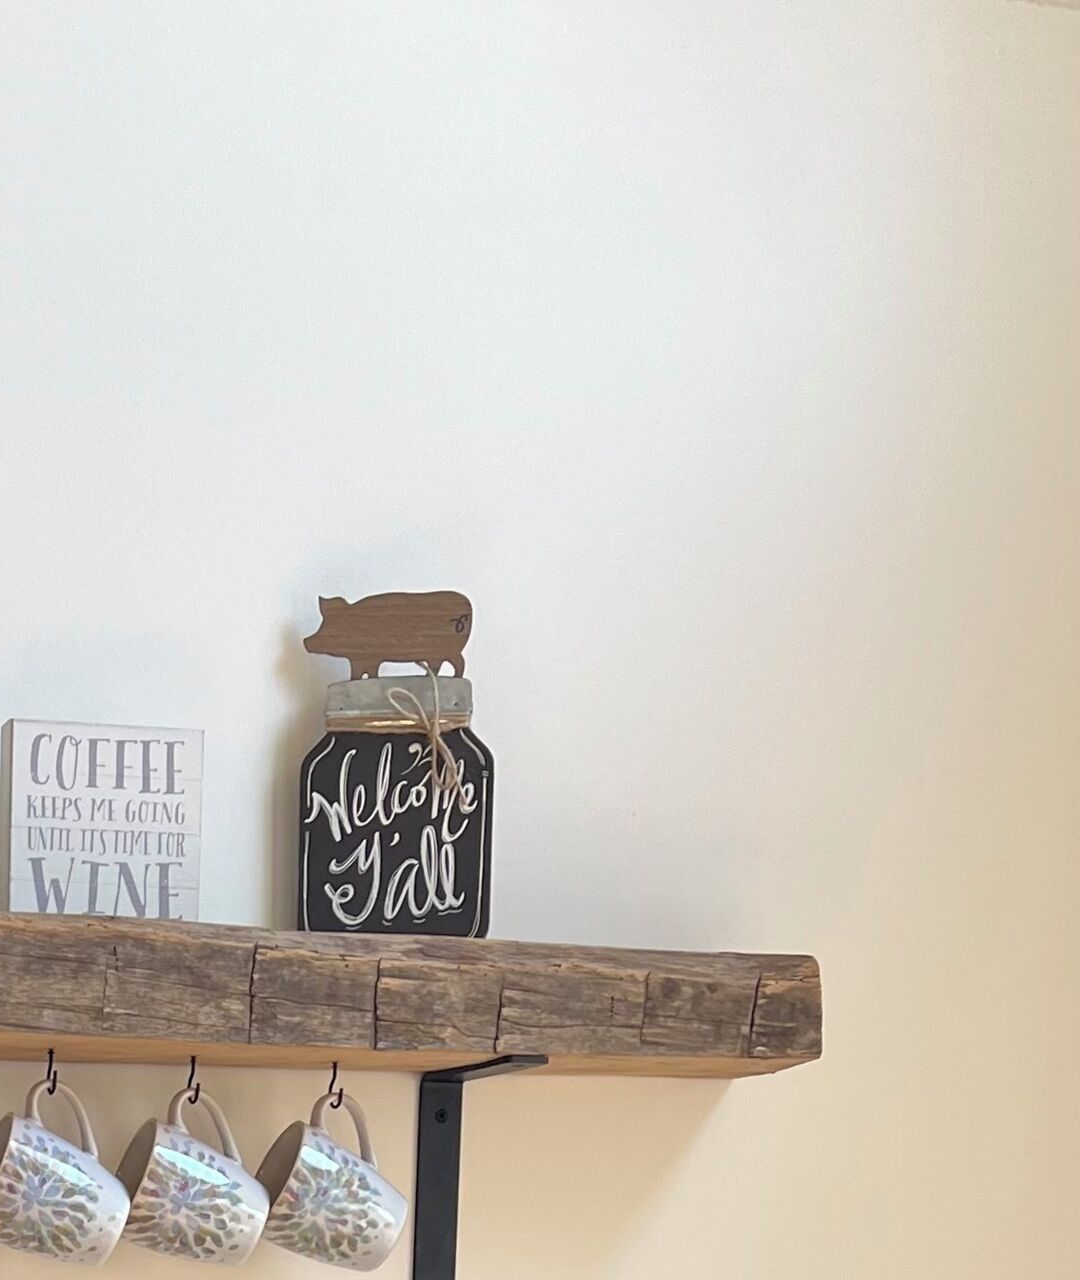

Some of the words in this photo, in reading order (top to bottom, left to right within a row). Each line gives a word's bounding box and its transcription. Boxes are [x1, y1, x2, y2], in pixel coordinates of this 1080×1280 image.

[30, 733, 186, 795] COFFEE
[305, 742, 478, 843] Welcome
[25, 794, 82, 823] KEEPS
[89, 798, 117, 823] ME
[125, 800, 186, 826] GOING
[27, 826, 73, 852] UNTIL
[113, 829, 151, 857] TIME
[157, 831, 187, 858] FOR
[27, 856, 184, 920] WINE
